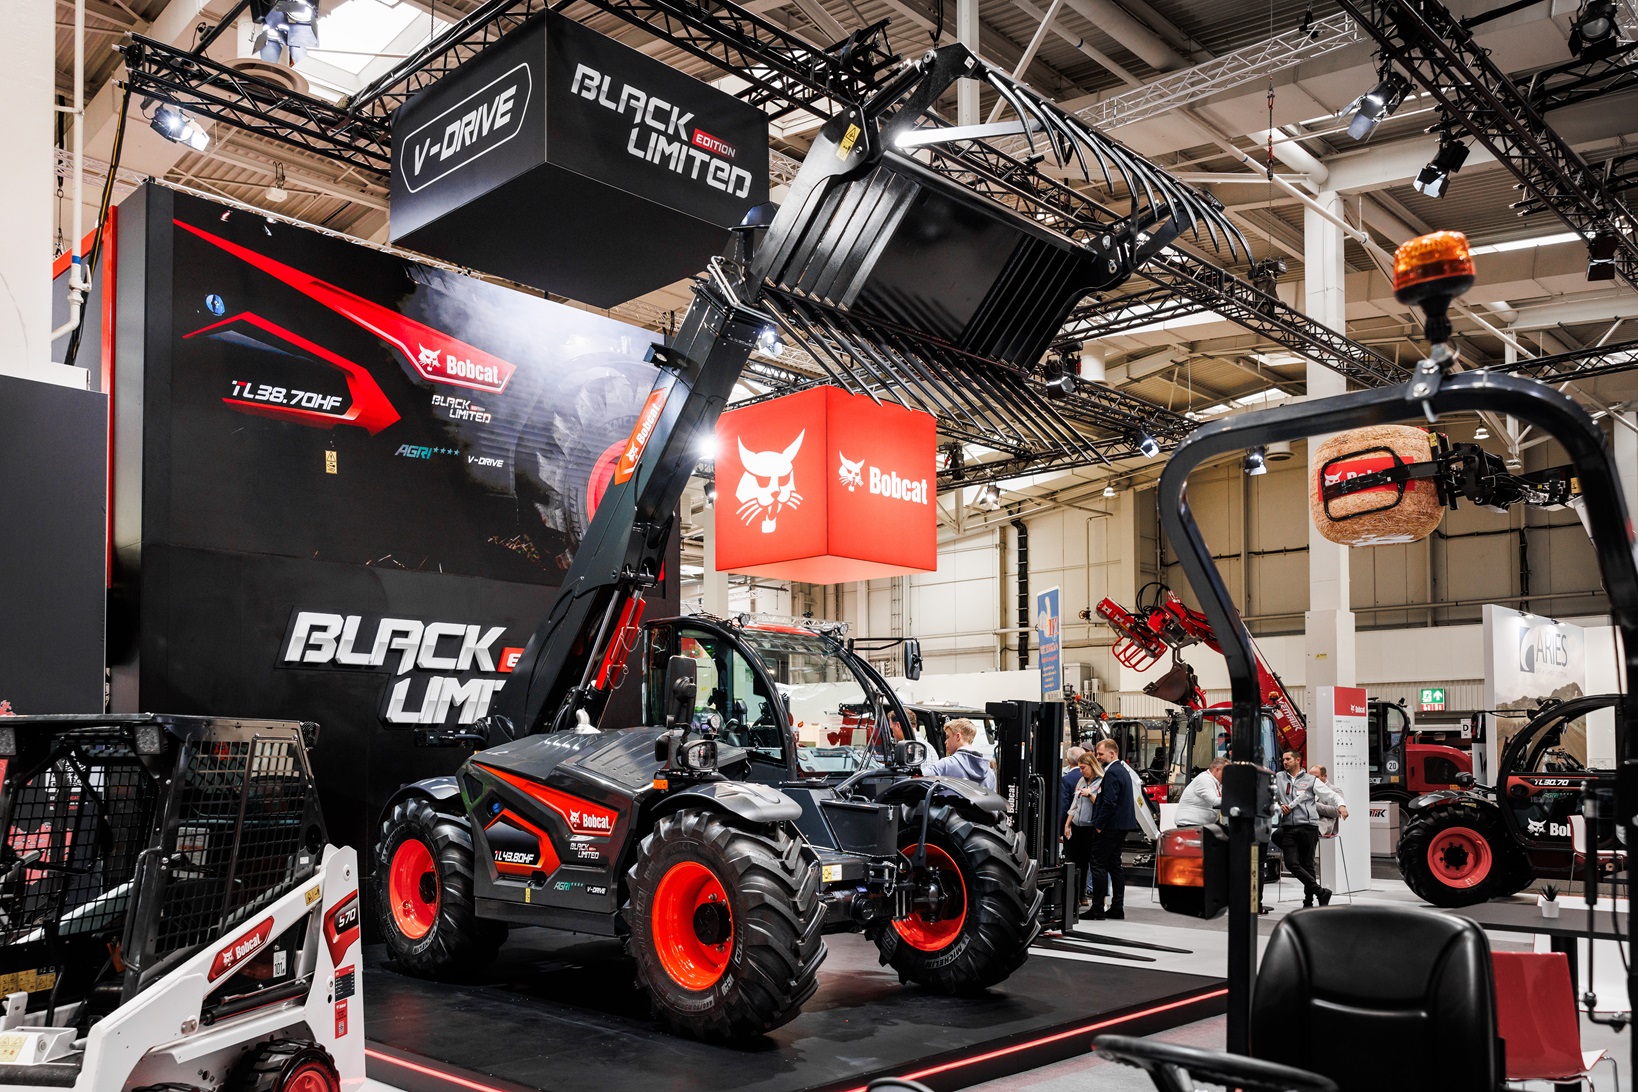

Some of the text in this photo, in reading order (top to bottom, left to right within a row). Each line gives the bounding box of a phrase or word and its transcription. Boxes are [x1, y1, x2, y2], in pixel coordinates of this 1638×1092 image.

[571, 63, 736, 158] BLACK EDITION
[414, 84, 517, 176] V-DRIVE
[627, 127, 752, 199] LIMITED
[446, 355, 499, 384] Bobcat
[232, 380, 342, 410] TL38.70HF
[432, 395, 470, 409] BLACK
[449, 409, 491, 423] LIMITED
[635, 403, 661, 446] Bobcat
[395, 444, 432, 459] AGRI
[468, 455, 504, 467] V-DRIVE
[869, 465, 928, 505] Bobcat
[284, 612, 507, 675] BLACK
[1536, 629, 1568, 667] ARIES
[1462, 724, 1469, 732] D
[1388, 762, 1397, 770] 20
[583, 814, 609, 828] Bobcat
[495, 850, 534, 863] TL43.80HF
[570, 843, 590, 851] BLACK
[339, 908, 356, 927] S70
[235, 933, 260, 959] Bobcat
[924, 944, 964, 969] MICHELIN
